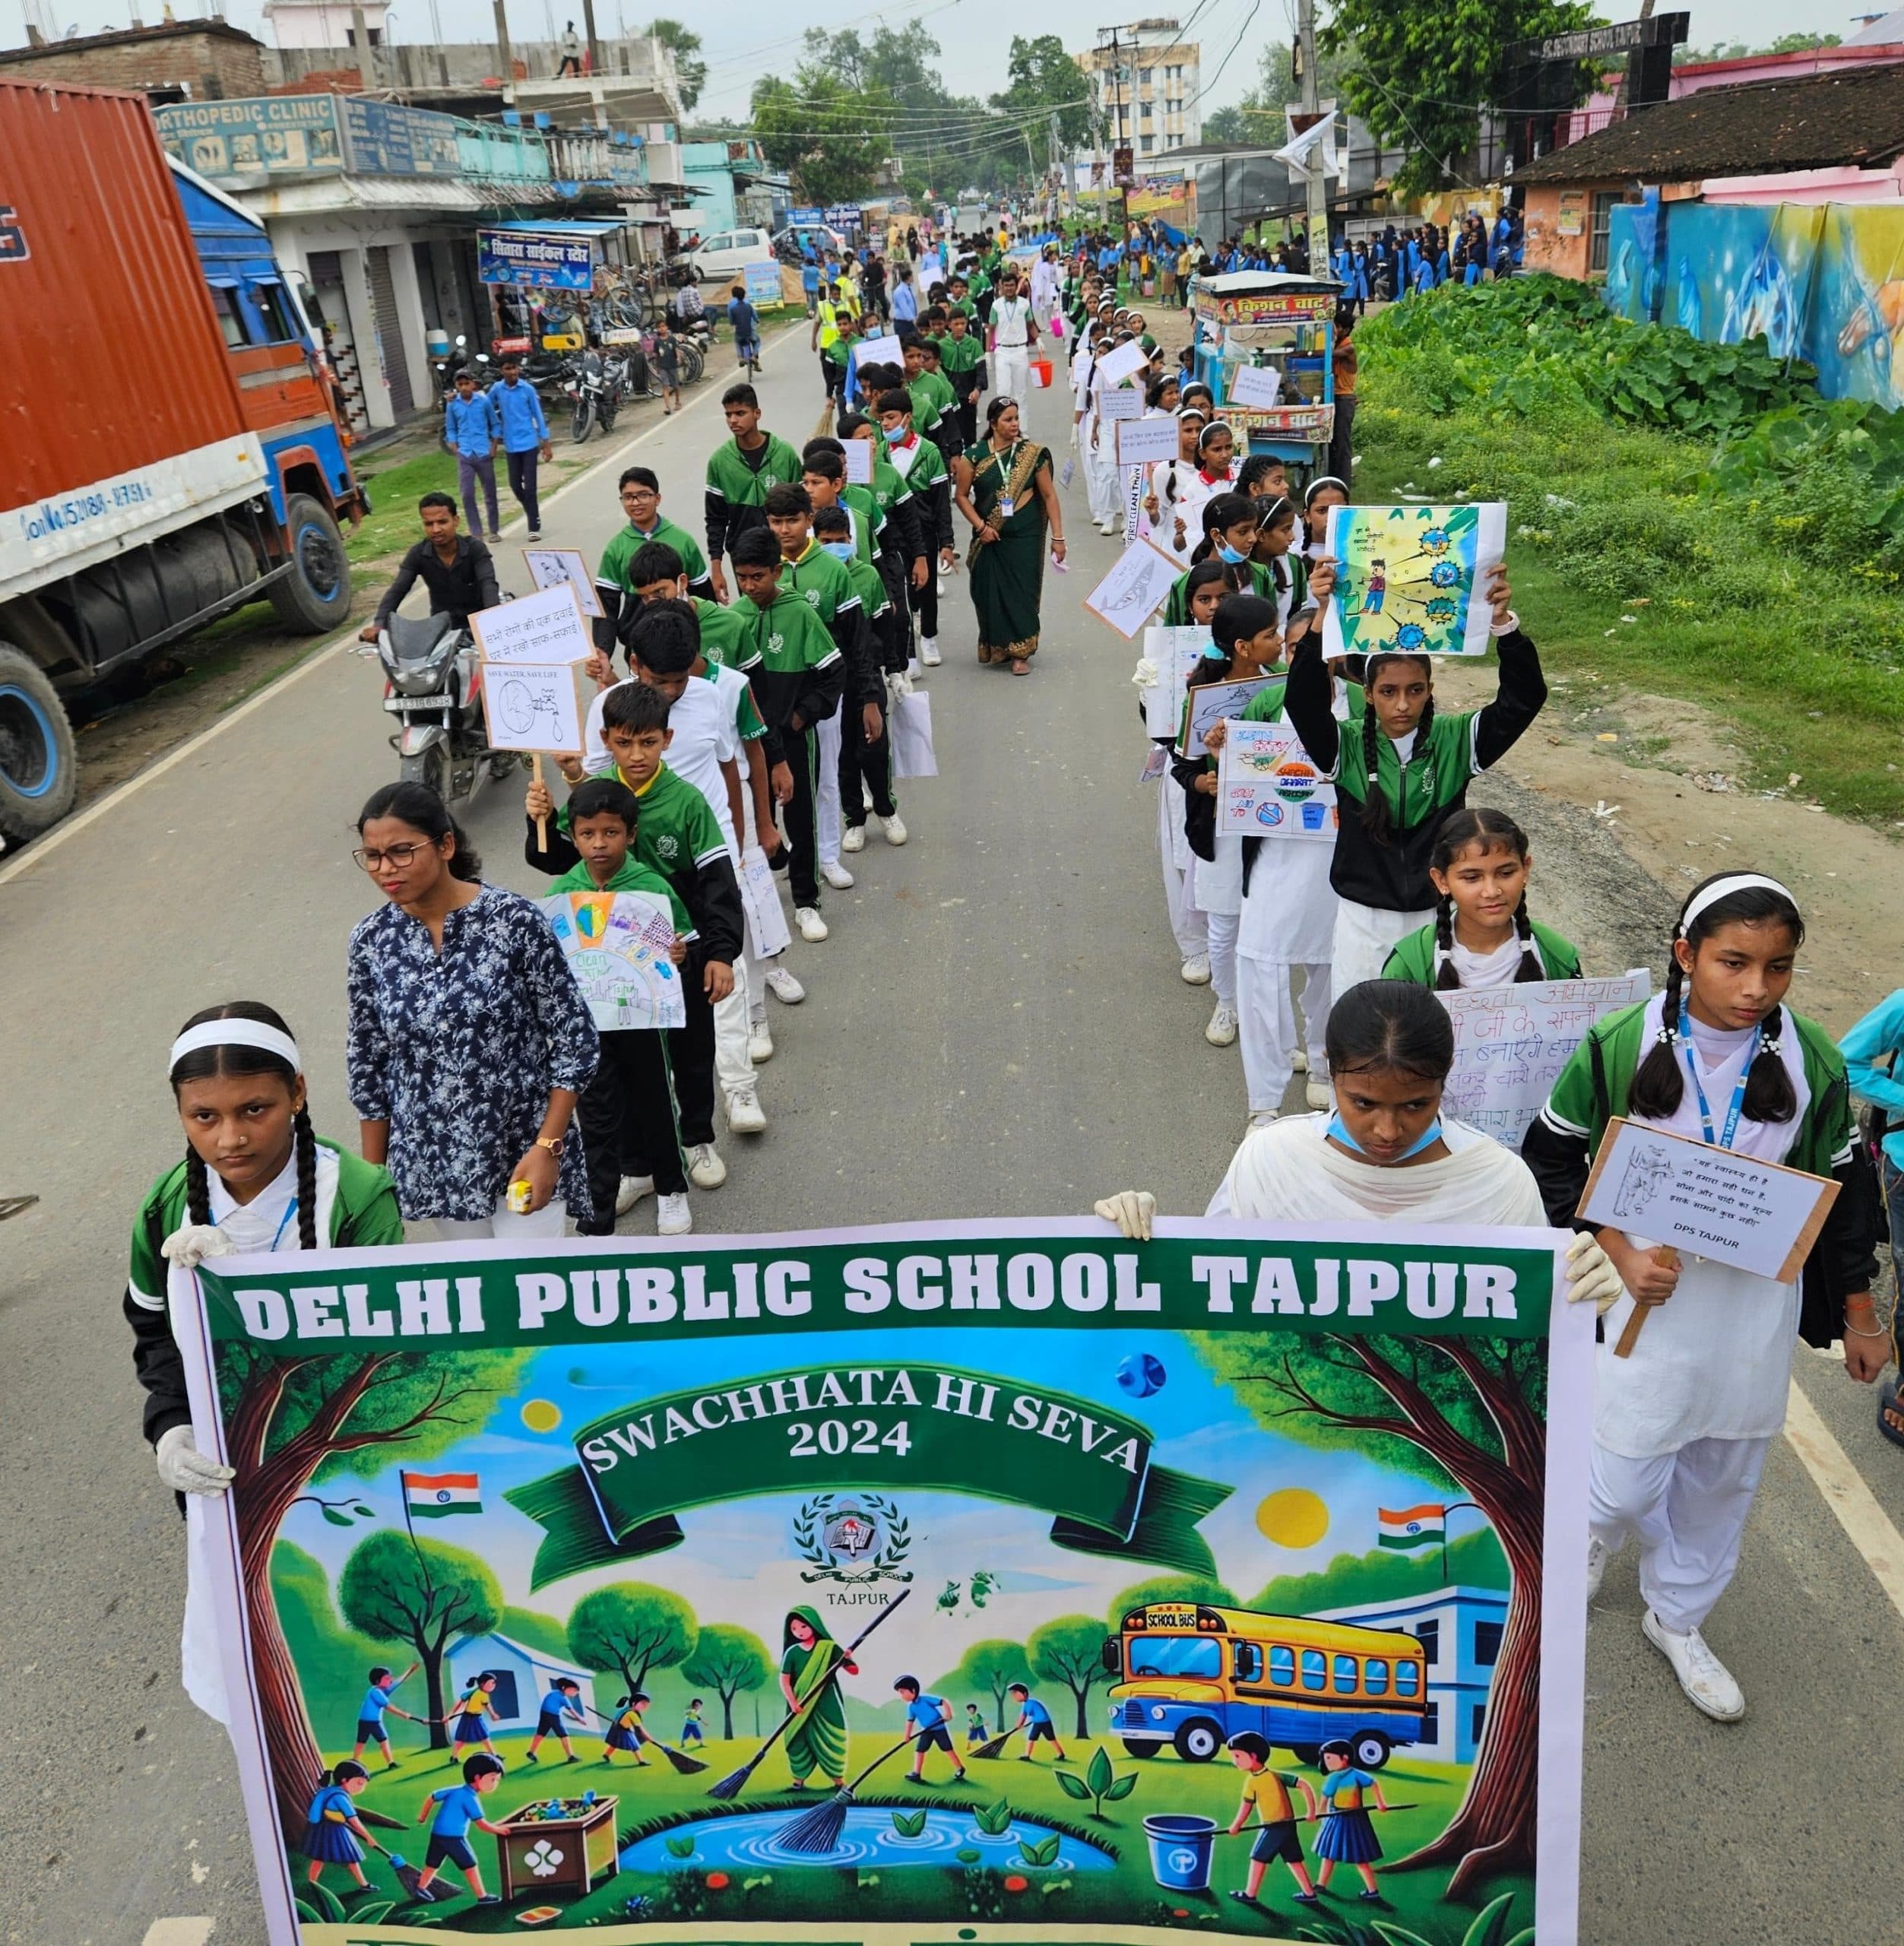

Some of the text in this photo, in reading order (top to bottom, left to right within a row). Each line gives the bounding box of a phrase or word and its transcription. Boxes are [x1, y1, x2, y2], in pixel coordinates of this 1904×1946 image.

[155, 100, 330, 132] ORTHOPEDIC CLINIC
[491, 238, 524, 257] सितारा
[1294, 296, 1326, 310] चाट
[1129, 493, 1139, 518] CLEAN
[1128, 521, 1136, 541] FIRST
[486, 629, 503, 644] सभी
[522, 616, 534, 631] की
[536, 613, 551, 628] एक
[1230, 808, 1246, 817] TO
[1475, 1009, 1506, 1039] जी
[1513, 1005, 1535, 1035] के
[1725, 1108, 1739, 1136] TAJPUR
[1681, 1168, 1693, 1177] जो
[1696, 1173, 1719, 1185] हमारा
[1722, 1181, 1738, 1192] सही
[1741, 1187, 1756, 1196] धन
[1749, 1174, 1759, 1183] ही
[1761, 1177, 1769, 1186] है
[1670, 1194, 1690, 1205] इसके
[1693, 1203, 1718, 1214] सामने
[1719, 1209, 1736, 1219] कुछ
[1676, 1181, 1695, 1193] सोना
[1697, 1188, 1714, 1199] और
[1738, 1201, 1750, 1210] का
[1752, 1206, 1773, 1216] मूल्य
[1673, 1222, 1740, 1249] DPS TAJPUR
[233, 1251, 1519, 1341] DELHI PUBLIC SCHOOL TAJPUR
[581, 1369, 1139, 1475] SWACHHATA HI SEVA
[787, 1419, 912, 1457] 2024
[814, 1571, 833, 1581] DELHI
[879, 1571, 903, 1582] SCHOOL
[826, 1593, 890, 1605] TAJPUR
[1148, 1613, 1178, 1627] SCHOOL
